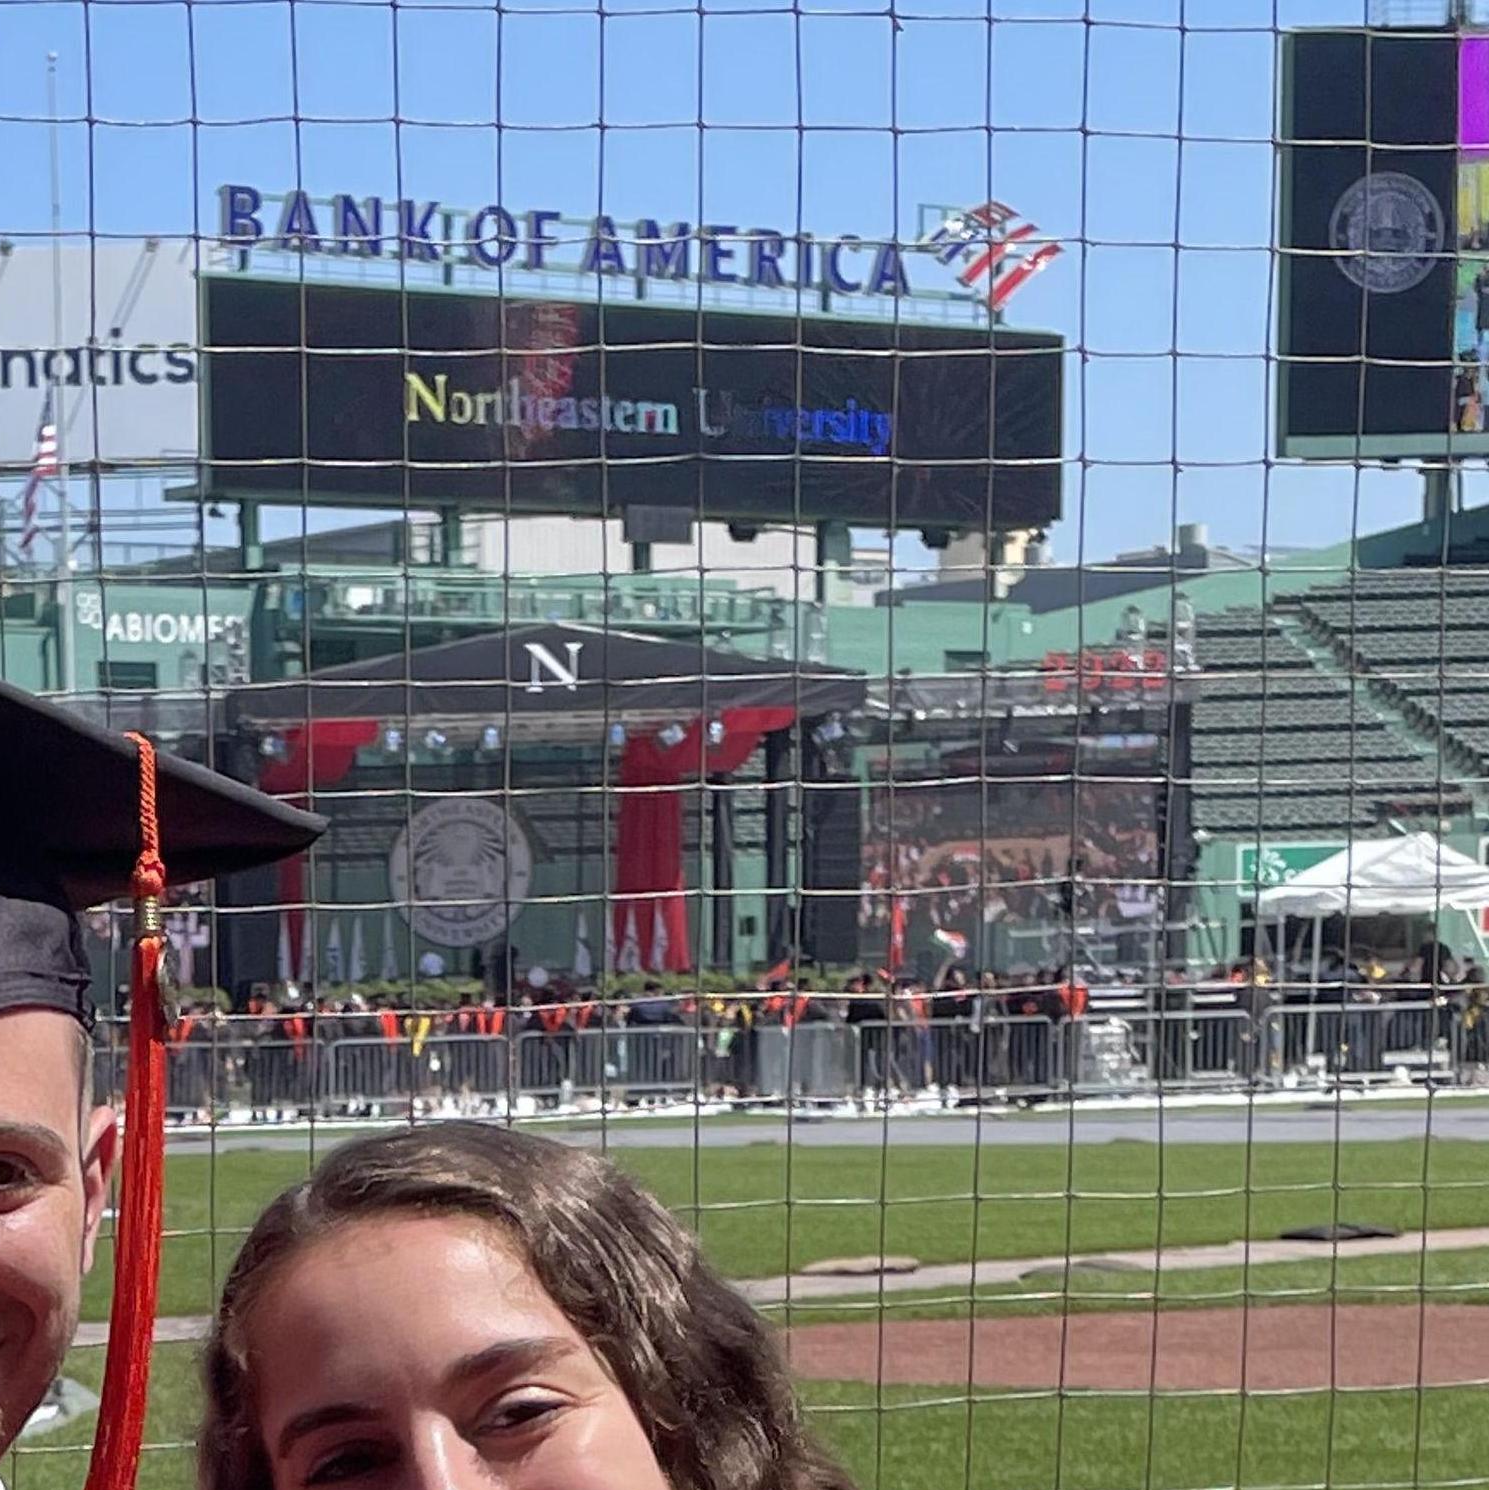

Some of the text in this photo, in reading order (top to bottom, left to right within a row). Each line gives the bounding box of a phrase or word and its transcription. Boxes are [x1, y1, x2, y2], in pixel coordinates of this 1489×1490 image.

[221, 184, 911, 297] BANK OF AMERICA
[404, 372, 679, 436] Northeastern
[523, 641, 584, 693] N
